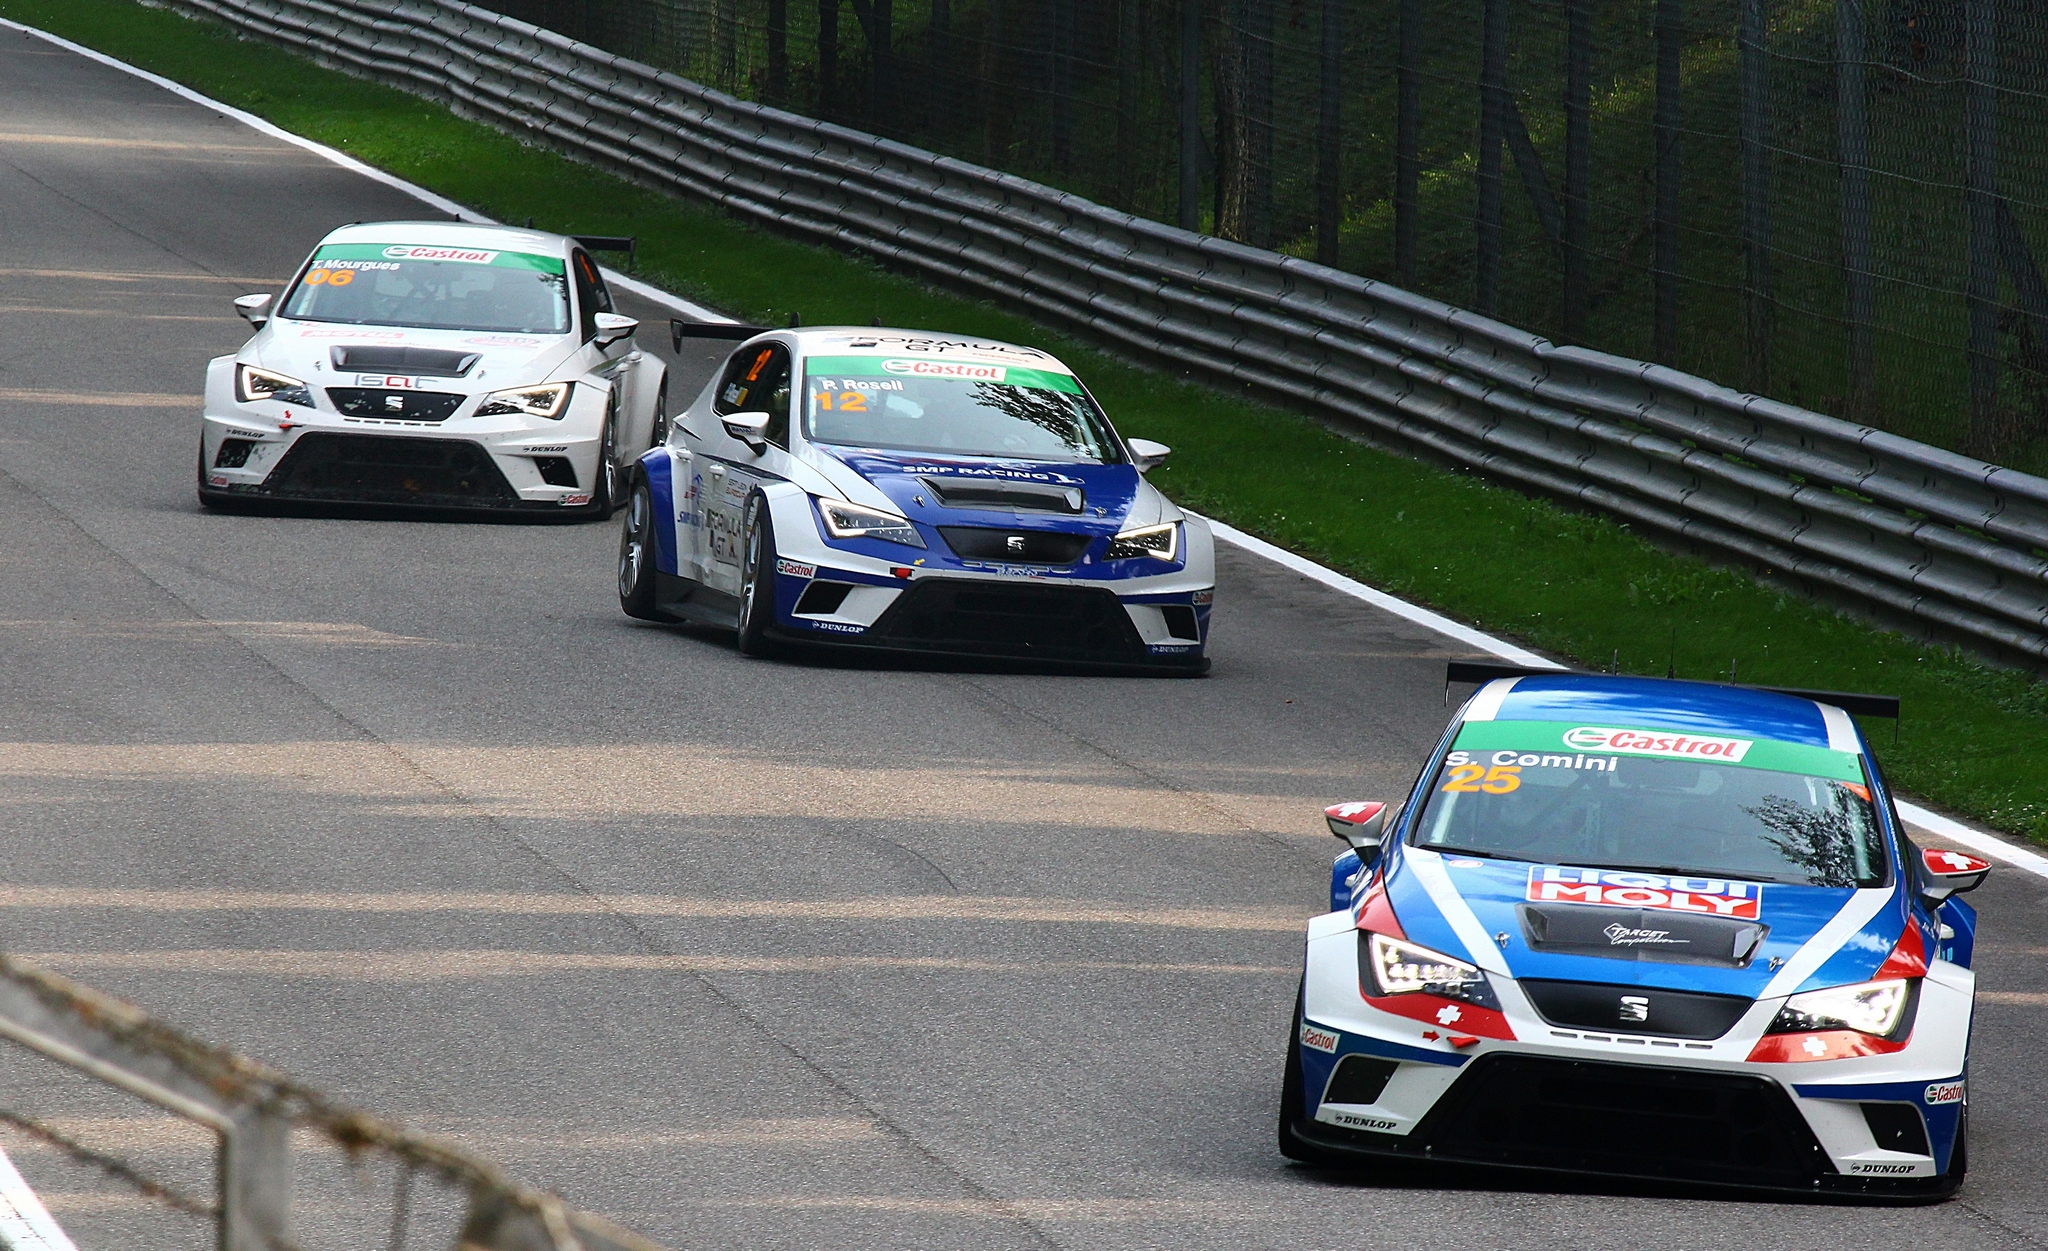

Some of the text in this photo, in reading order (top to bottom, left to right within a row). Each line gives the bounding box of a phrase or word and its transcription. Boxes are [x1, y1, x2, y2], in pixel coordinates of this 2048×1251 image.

[409, 247, 490, 261] Castrol
[323, 260, 400, 271] Mourgues
[304, 269, 356, 287] 06
[905, 344, 955, 353] GT
[913, 362, 999, 379] Castrol
[843, 379, 904, 391] Rosell
[814, 391, 868, 412] 12
[902, 465, 953, 474] SMP
[958, 467, 1049, 481] RACING
[784, 562, 814, 577] Castrol
[820, 623, 864, 634] DUNLOP
[1609, 732, 1735, 758] Castrol
[1445, 751, 1619, 773] S. Comini
[1441, 764, 1522, 794] 25
[1543, 867, 1748, 898] LIQUI
[1540, 882, 1754, 915] MOLY
[1304, 1028, 1336, 1050] Castrol
[1343, 1115, 1397, 1130] DUNLOP
[1861, 1164, 1915, 1174] DUNLOP
